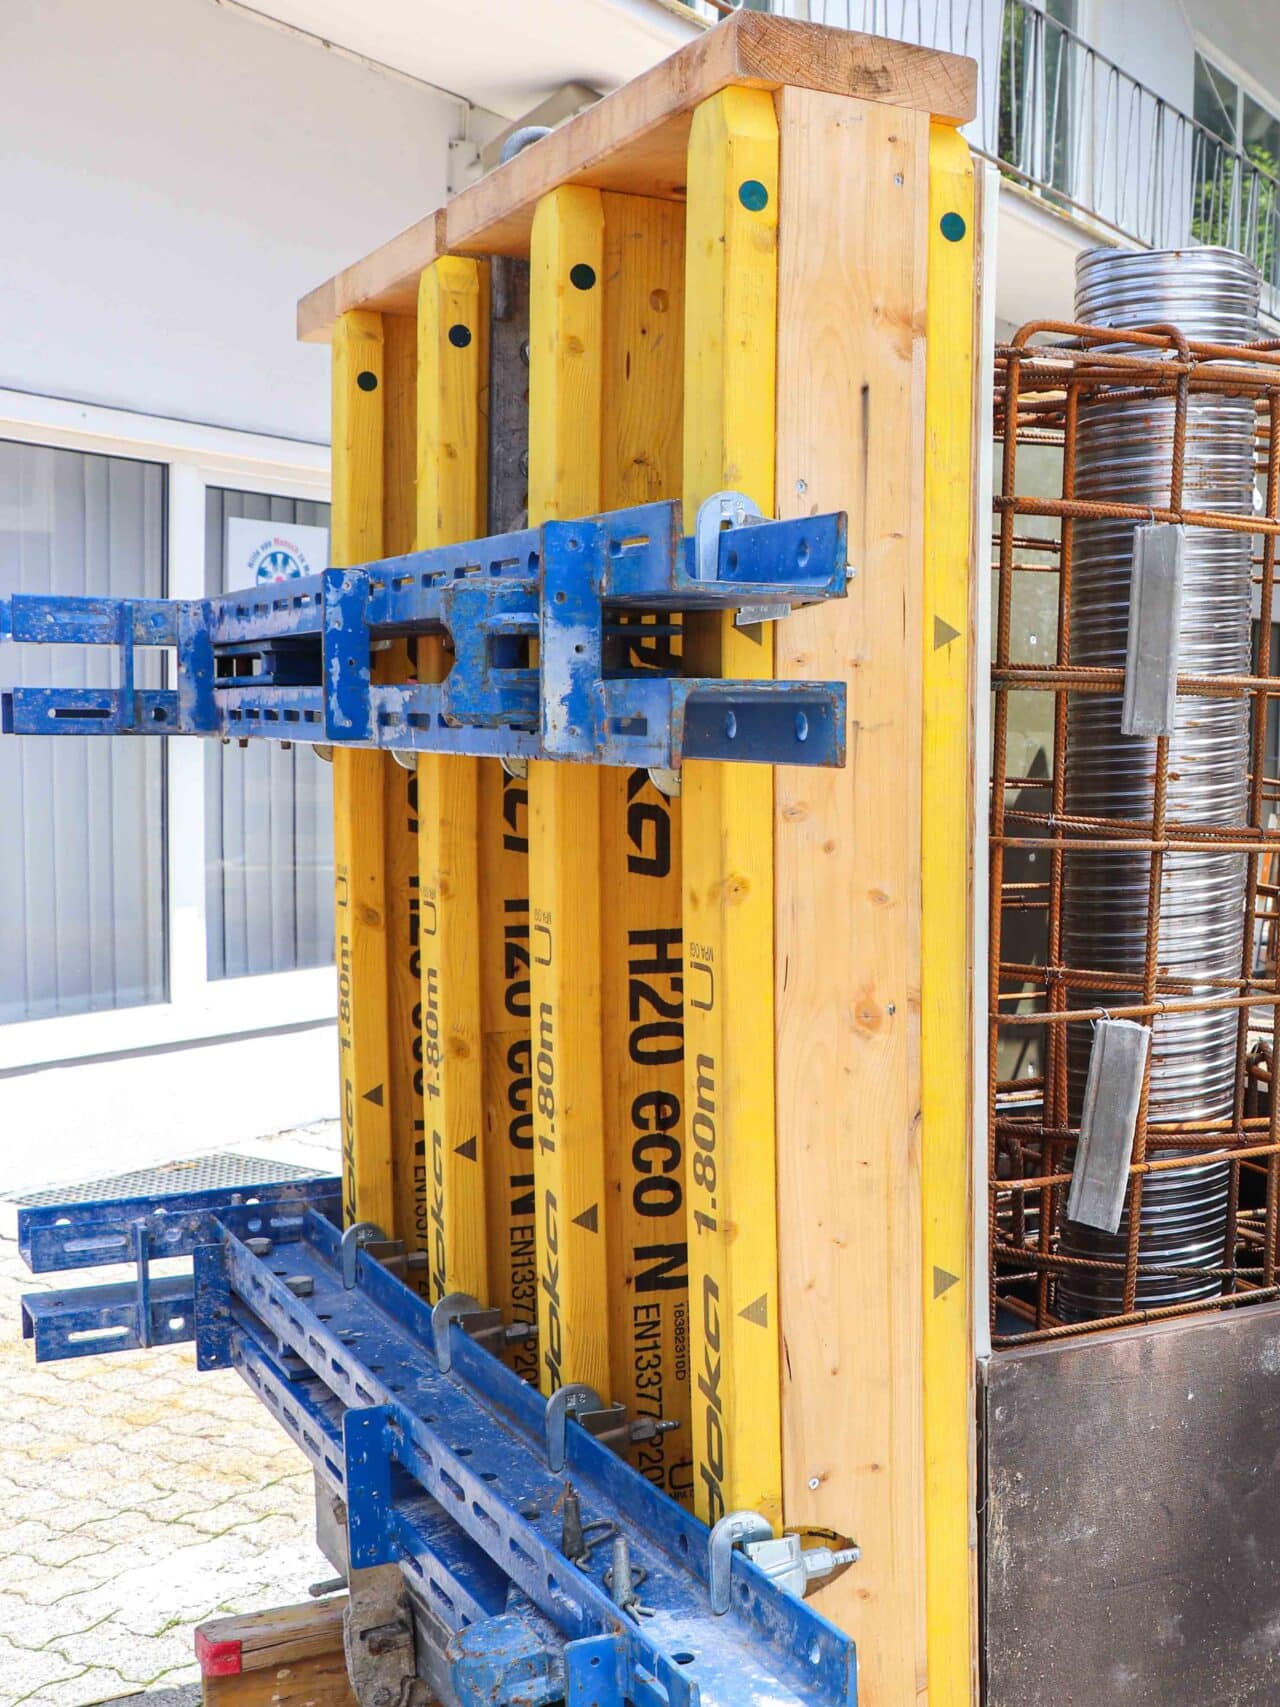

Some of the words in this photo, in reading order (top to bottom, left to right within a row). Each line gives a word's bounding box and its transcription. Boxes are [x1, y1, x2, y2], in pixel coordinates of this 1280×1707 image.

[339, 935, 352, 1053] 1.80m
[425, 968, 441, 1101] 1.80m
[628, 928, 684, 1066] H20
[536, 1002, 556, 1156] 1.80m
[631, 1090, 682, 1217] eco
[692, 1054, 717, 1235] 1.80m
[633, 1243, 688, 1293] N
[633, 1302, 662, 1419] EN13377
[673, 1302, 686, 1381] 18382310D
[697, 1275, 725, 1527] doka
